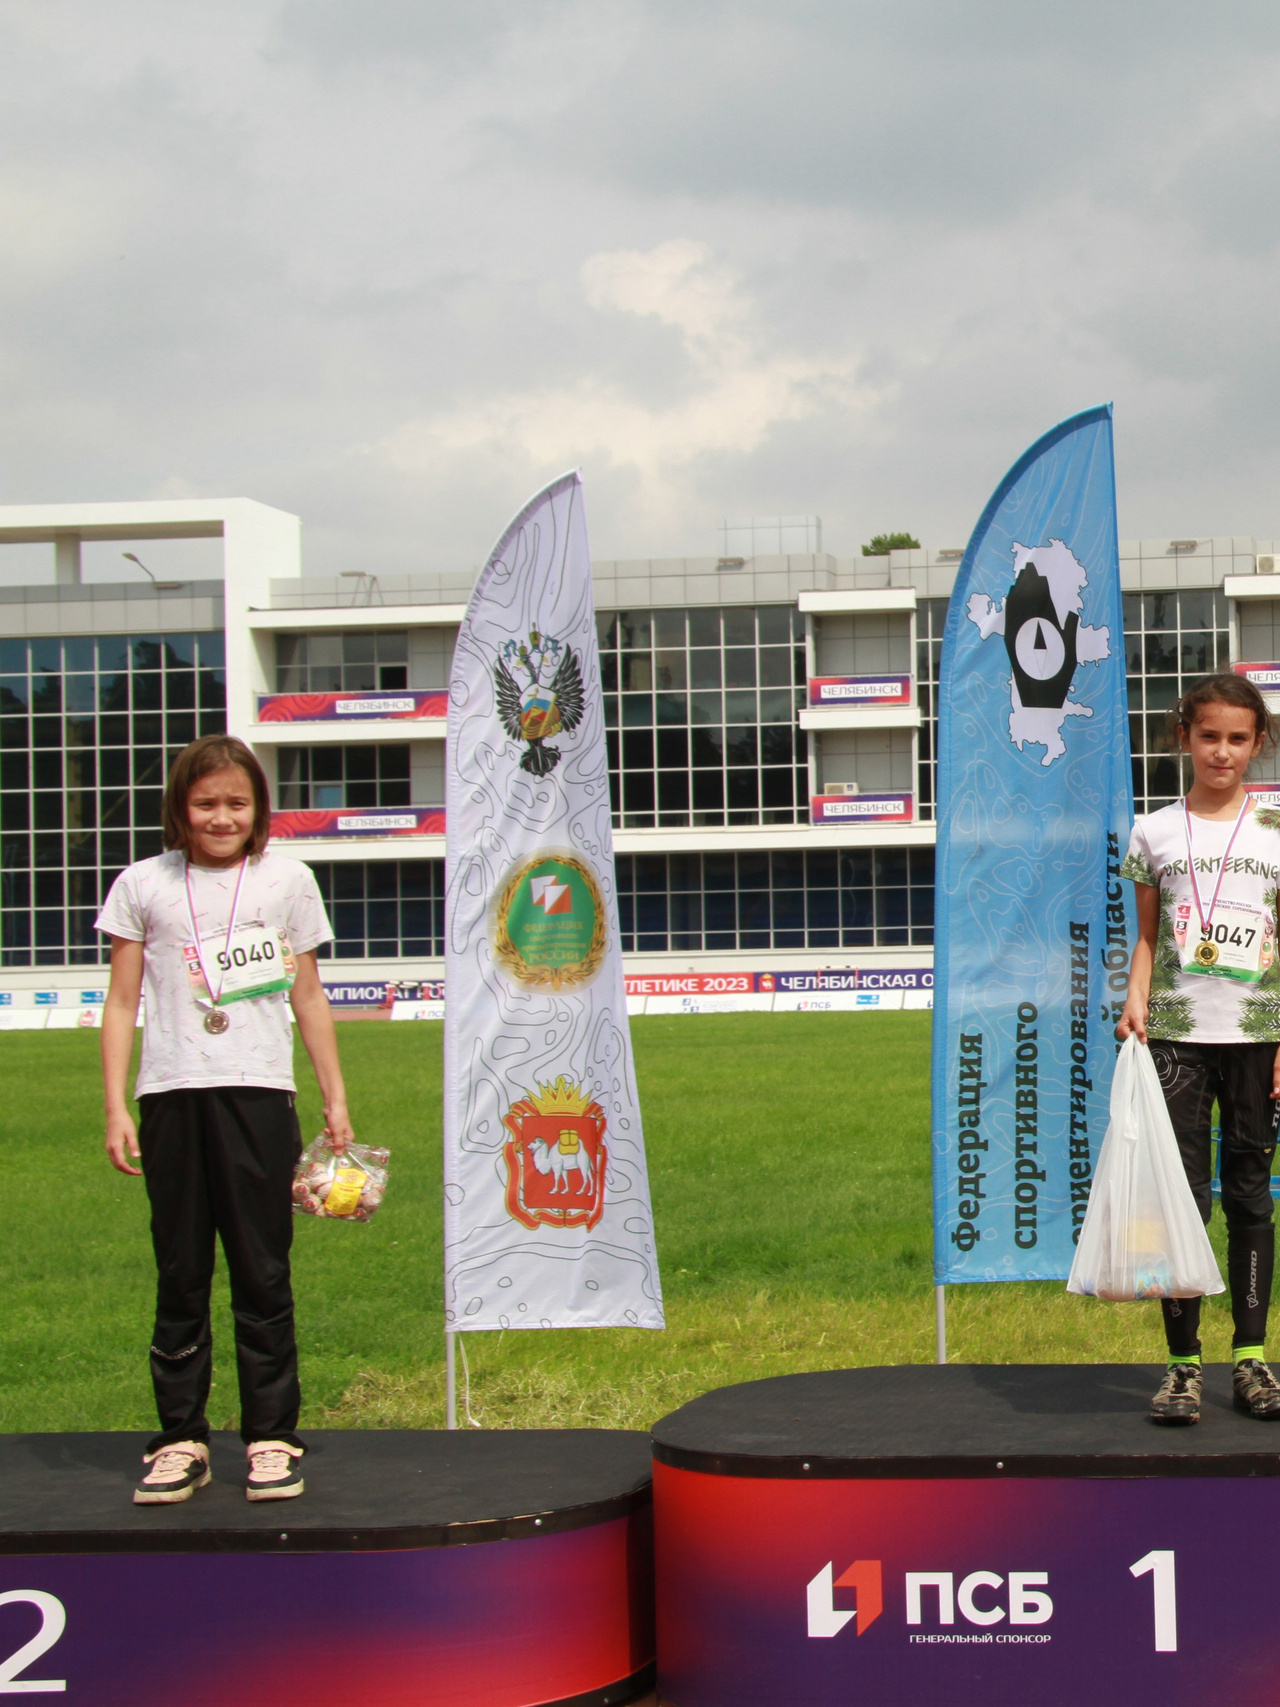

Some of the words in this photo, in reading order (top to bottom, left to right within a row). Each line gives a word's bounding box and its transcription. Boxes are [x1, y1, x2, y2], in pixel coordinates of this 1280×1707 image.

[822, 685, 899, 696] ЧЕЛЯБИНСК
[338, 699, 412, 711] ЧЕЛЯБИНСК
[825, 803, 902, 814] ЧЕЛЯБИНСК
[339, 816, 414, 828] ЧЕЛЯБИНСК
[1101, 832, 1129, 993] области
[1200, 922, 1256, 948] 9047
[217, 941, 275, 971] 9040
[624, 978, 699, 993] ТЛЕТИКЕ
[703, 977, 748, 991] 2023
[781, 974, 917, 990] ЧЕЛЯБИНСКАЯ
[323, 986, 409, 1001] МПИОНАТ
[811, 1001, 831, 1009] ПСБ
[1015, 1002, 1046, 1249] спортивного
[951, 1033, 988, 1252] Федерация
[1249, 1250, 1257, 1293] NORD
[905, 1570, 1054, 1626] ПСБ
[1129, 1550, 1177, 1652] 1
[0, 1588, 67, 1693] 2
[909, 1632, 993, 1644] ГЕНЕРАЛЬНЫЙ
[995, 1633, 1052, 1644] СПОНСОР
